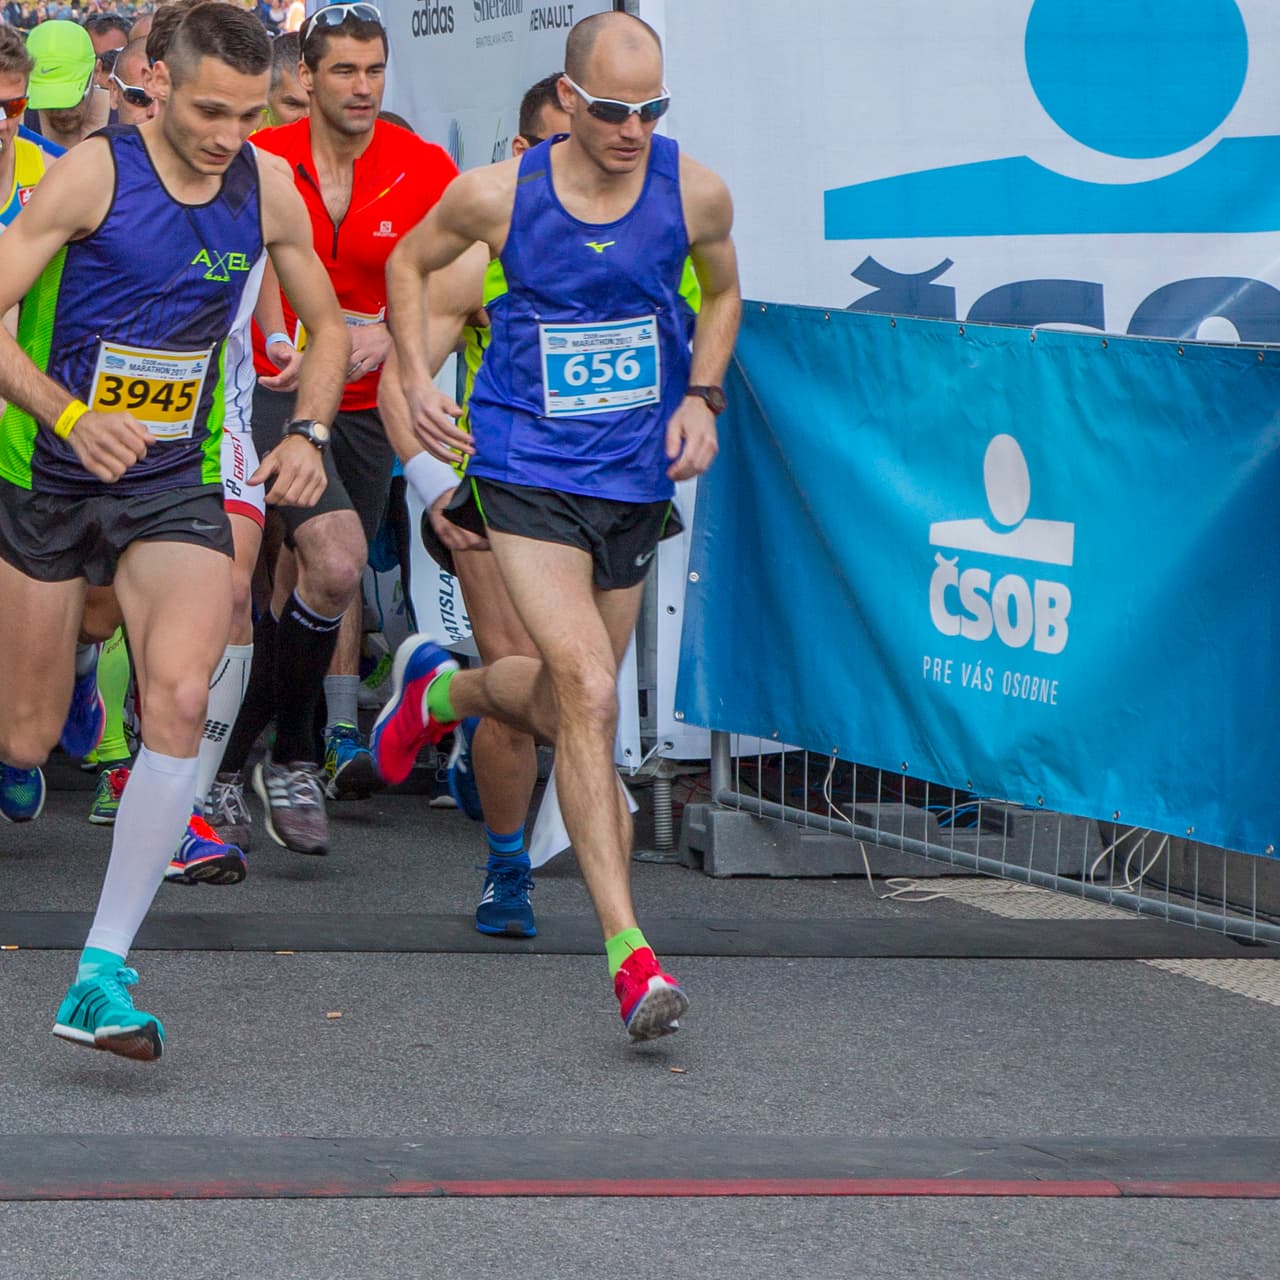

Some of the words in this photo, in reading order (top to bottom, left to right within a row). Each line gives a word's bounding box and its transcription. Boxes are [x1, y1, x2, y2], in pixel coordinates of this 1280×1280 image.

[529, 5, 574, 32] RENAULT
[129, 363, 170, 374] MARATHON
[170, 368, 188, 377] 2017
[563, 349, 641, 387] 656
[98, 375, 197, 413] 3945
[929, 551, 1072, 655] ČSOB
[923, 655, 953, 684] PRE
[961, 660, 994, 693] VÁS
[1002, 671, 1059, 706] OSOBNE
